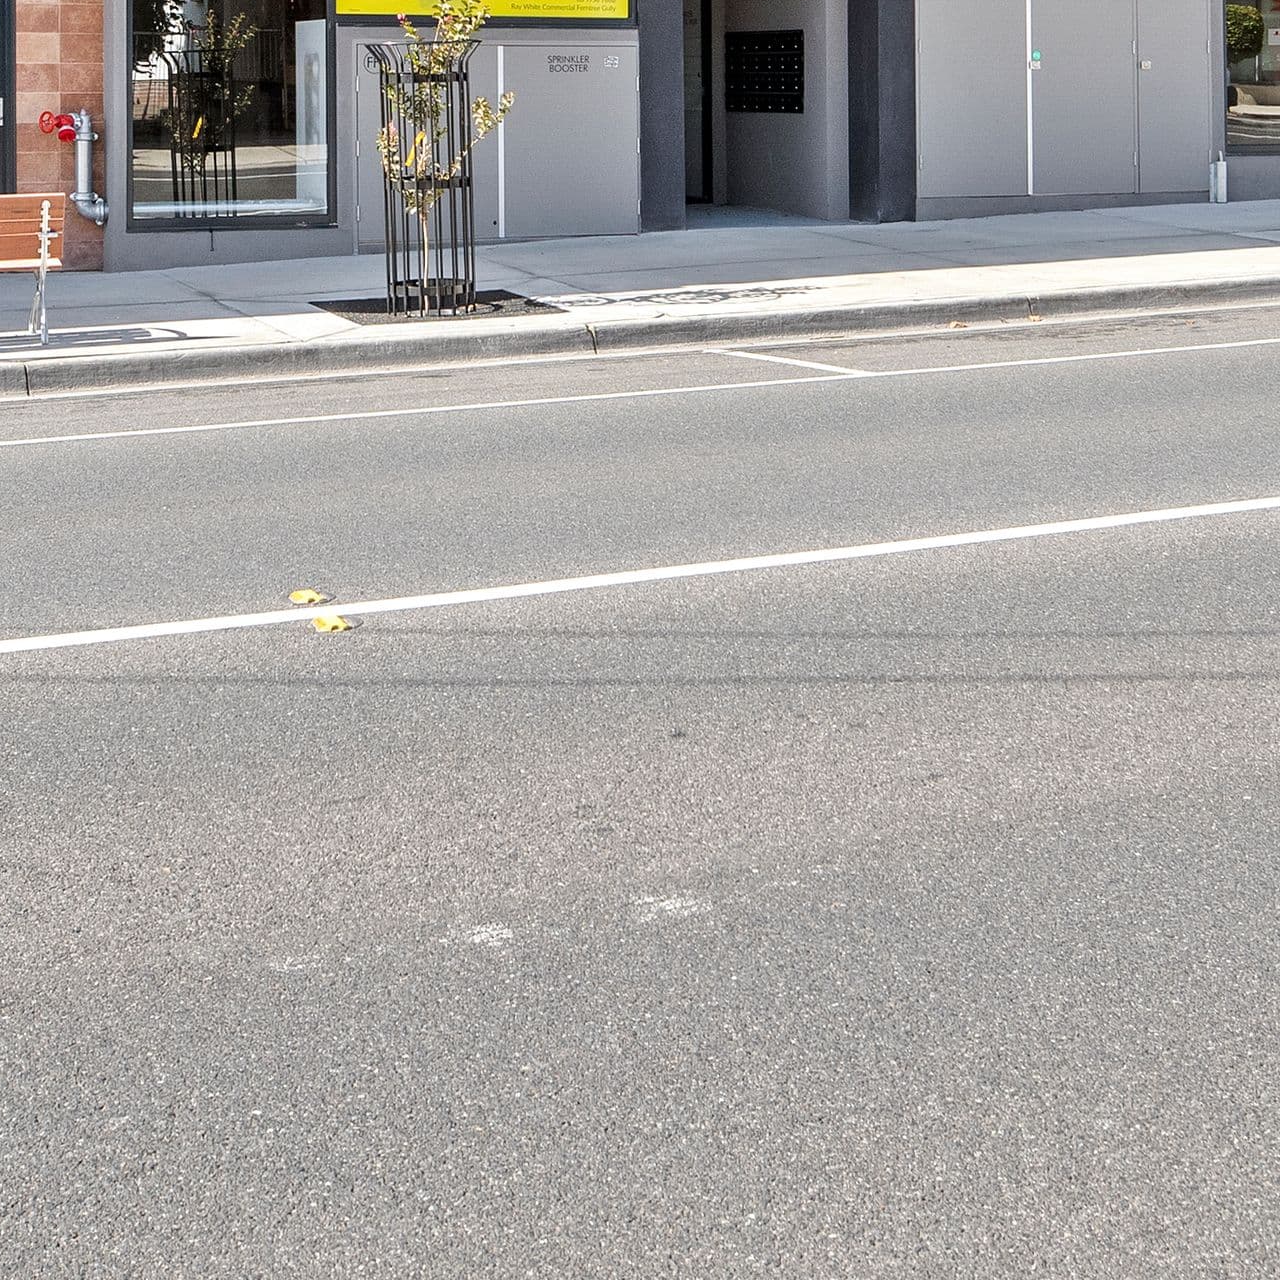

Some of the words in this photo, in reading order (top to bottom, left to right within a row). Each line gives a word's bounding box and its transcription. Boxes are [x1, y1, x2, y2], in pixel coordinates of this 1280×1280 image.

[511, 3, 522, 11] Ray
[542, 3, 575, 11] Commercial
[547, 55, 590, 64] SPRINKLER
[549, 64, 589, 72] BOOSTER
